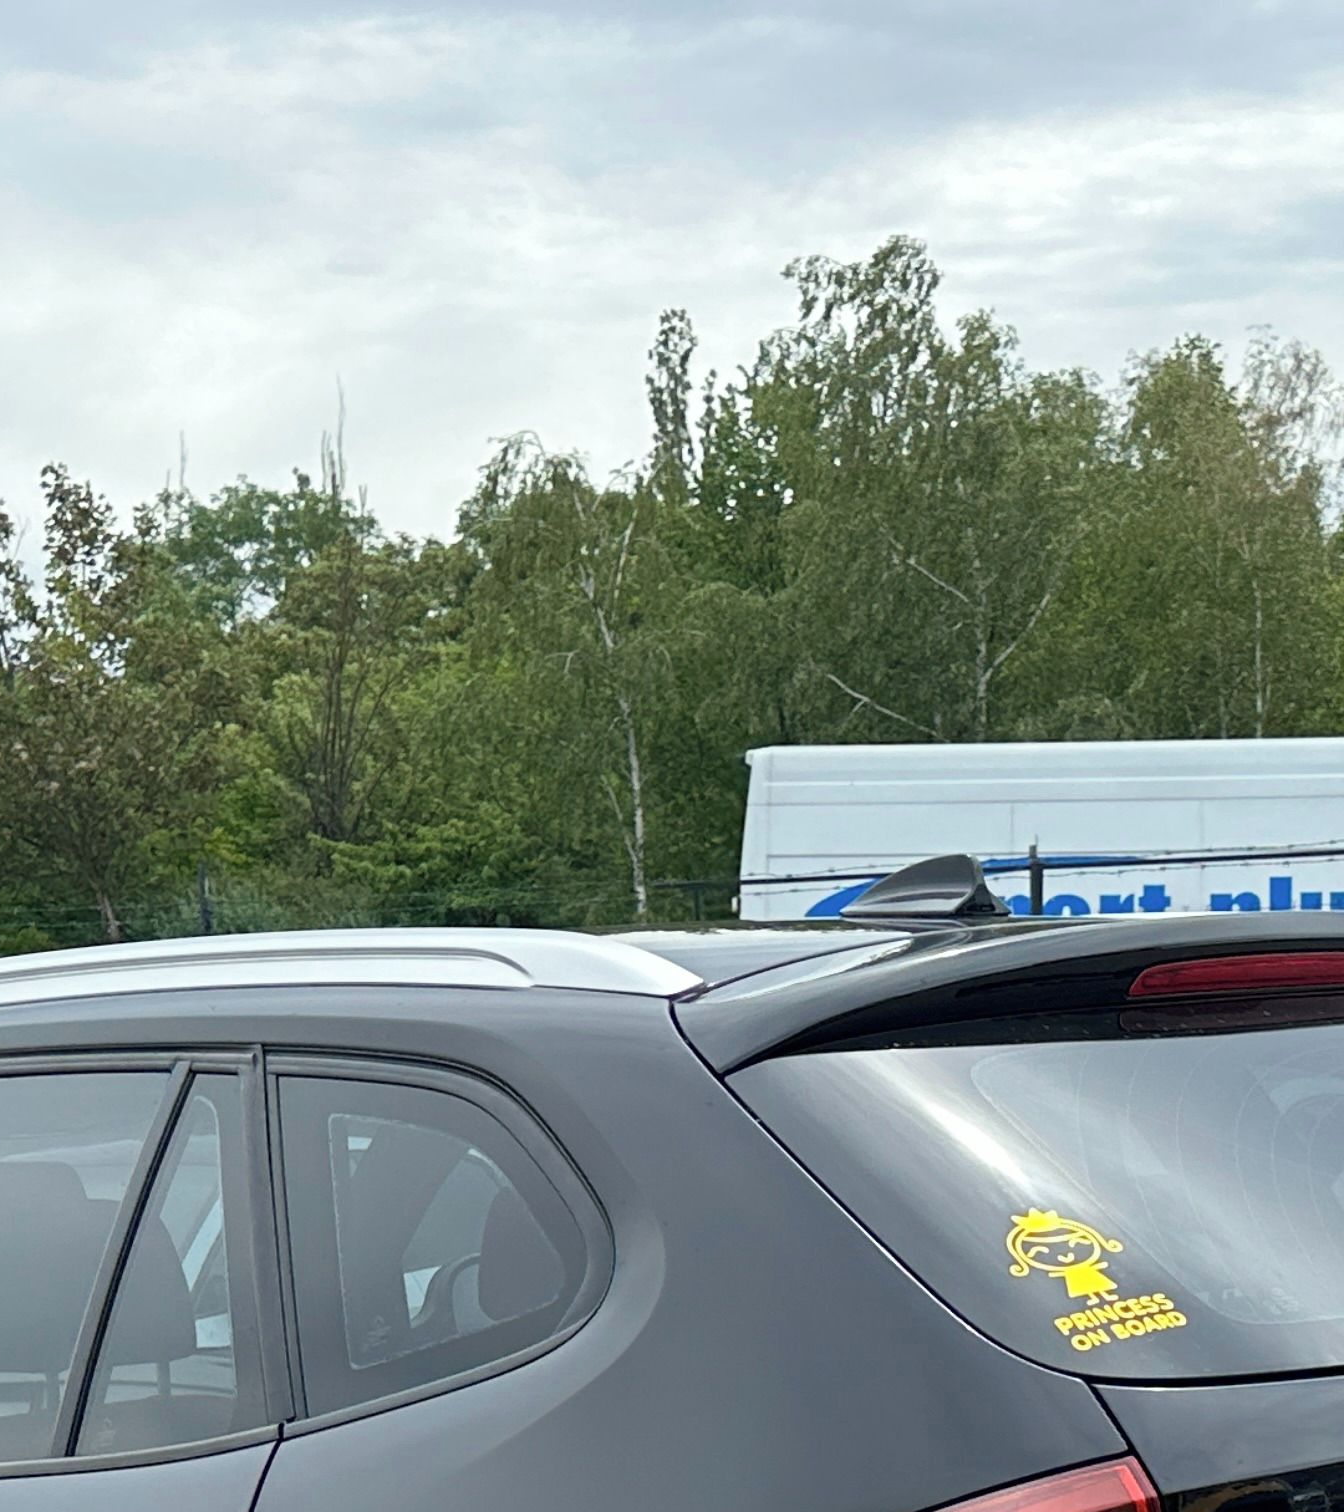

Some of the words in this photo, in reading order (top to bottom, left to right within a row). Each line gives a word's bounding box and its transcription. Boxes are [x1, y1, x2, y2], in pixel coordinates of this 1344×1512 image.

[1054, 1293, 1174, 1336] PRINCESS
[1071, 1329, 1111, 1351] ON
[1110, 1311, 1187, 1340] BOARD
